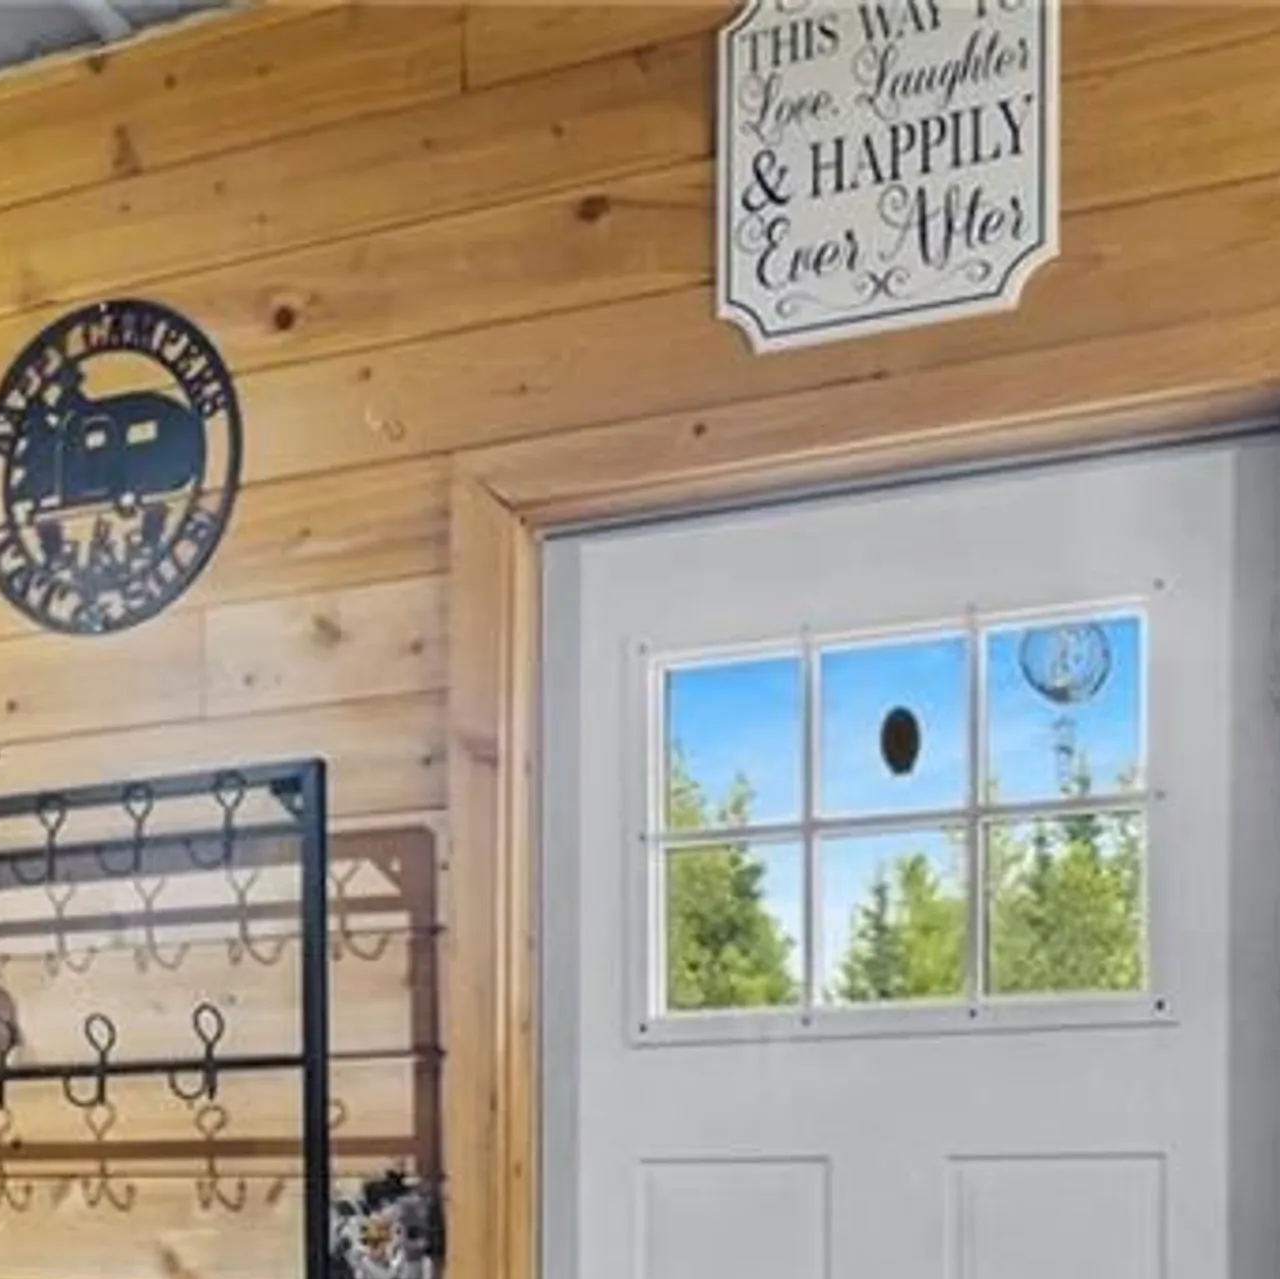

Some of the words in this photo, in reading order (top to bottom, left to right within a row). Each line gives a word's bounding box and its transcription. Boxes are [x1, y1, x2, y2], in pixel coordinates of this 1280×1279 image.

[742, 19, 839, 71] THIS
[858, 0, 942, 41] WAY
[851, 27, 1028, 120] Laughter
[741, 149, 793, 213] &
[810, 93, 1033, 198] HAPPILY
[734, 214, 860, 291] Ever
[877, 184, 1025, 270] After
